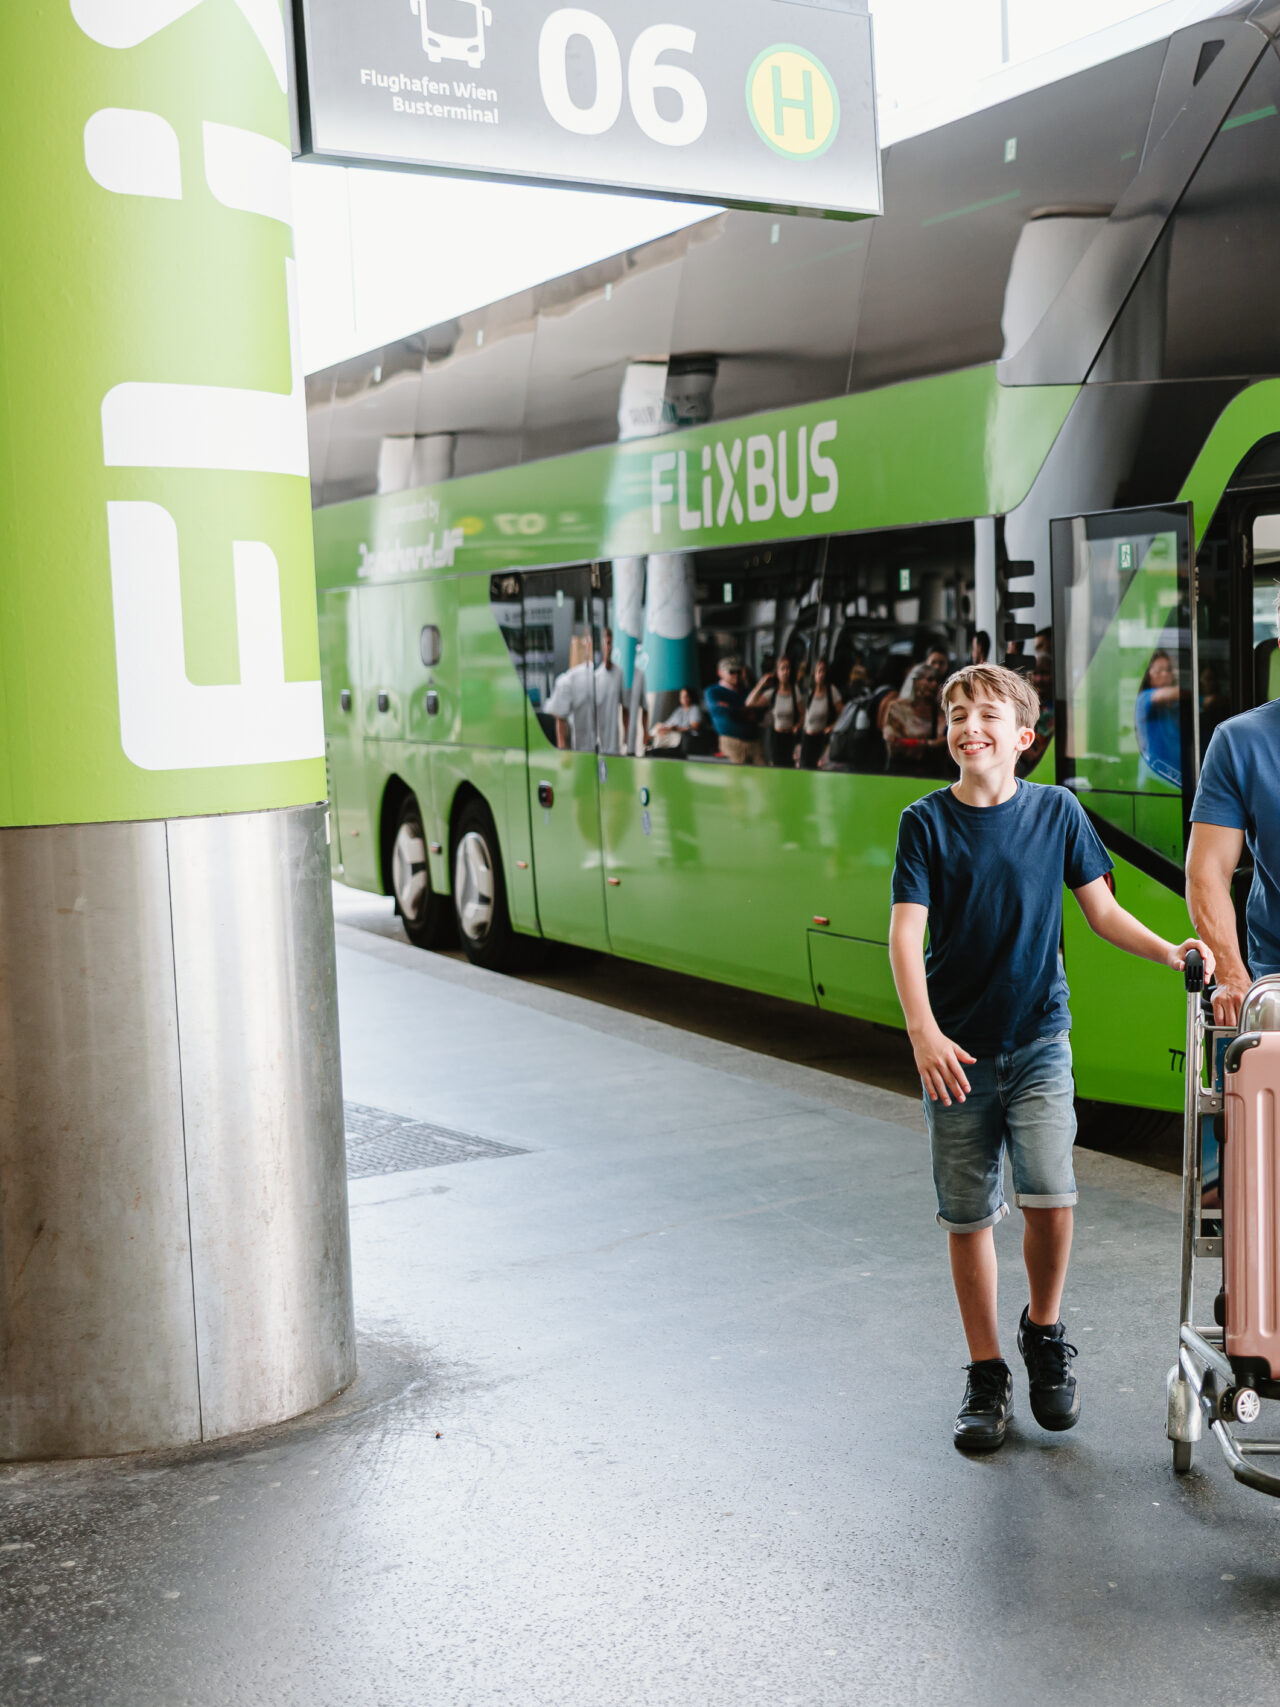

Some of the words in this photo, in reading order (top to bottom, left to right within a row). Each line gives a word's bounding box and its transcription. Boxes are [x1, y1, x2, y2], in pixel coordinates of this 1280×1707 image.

[360, 68, 449, 97] Flughafen
[452, 82, 498, 101] Wien
[538, 7, 708, 147] 06
[771, 65, 816, 140] H
[392, 95, 499, 124] Busterminal
